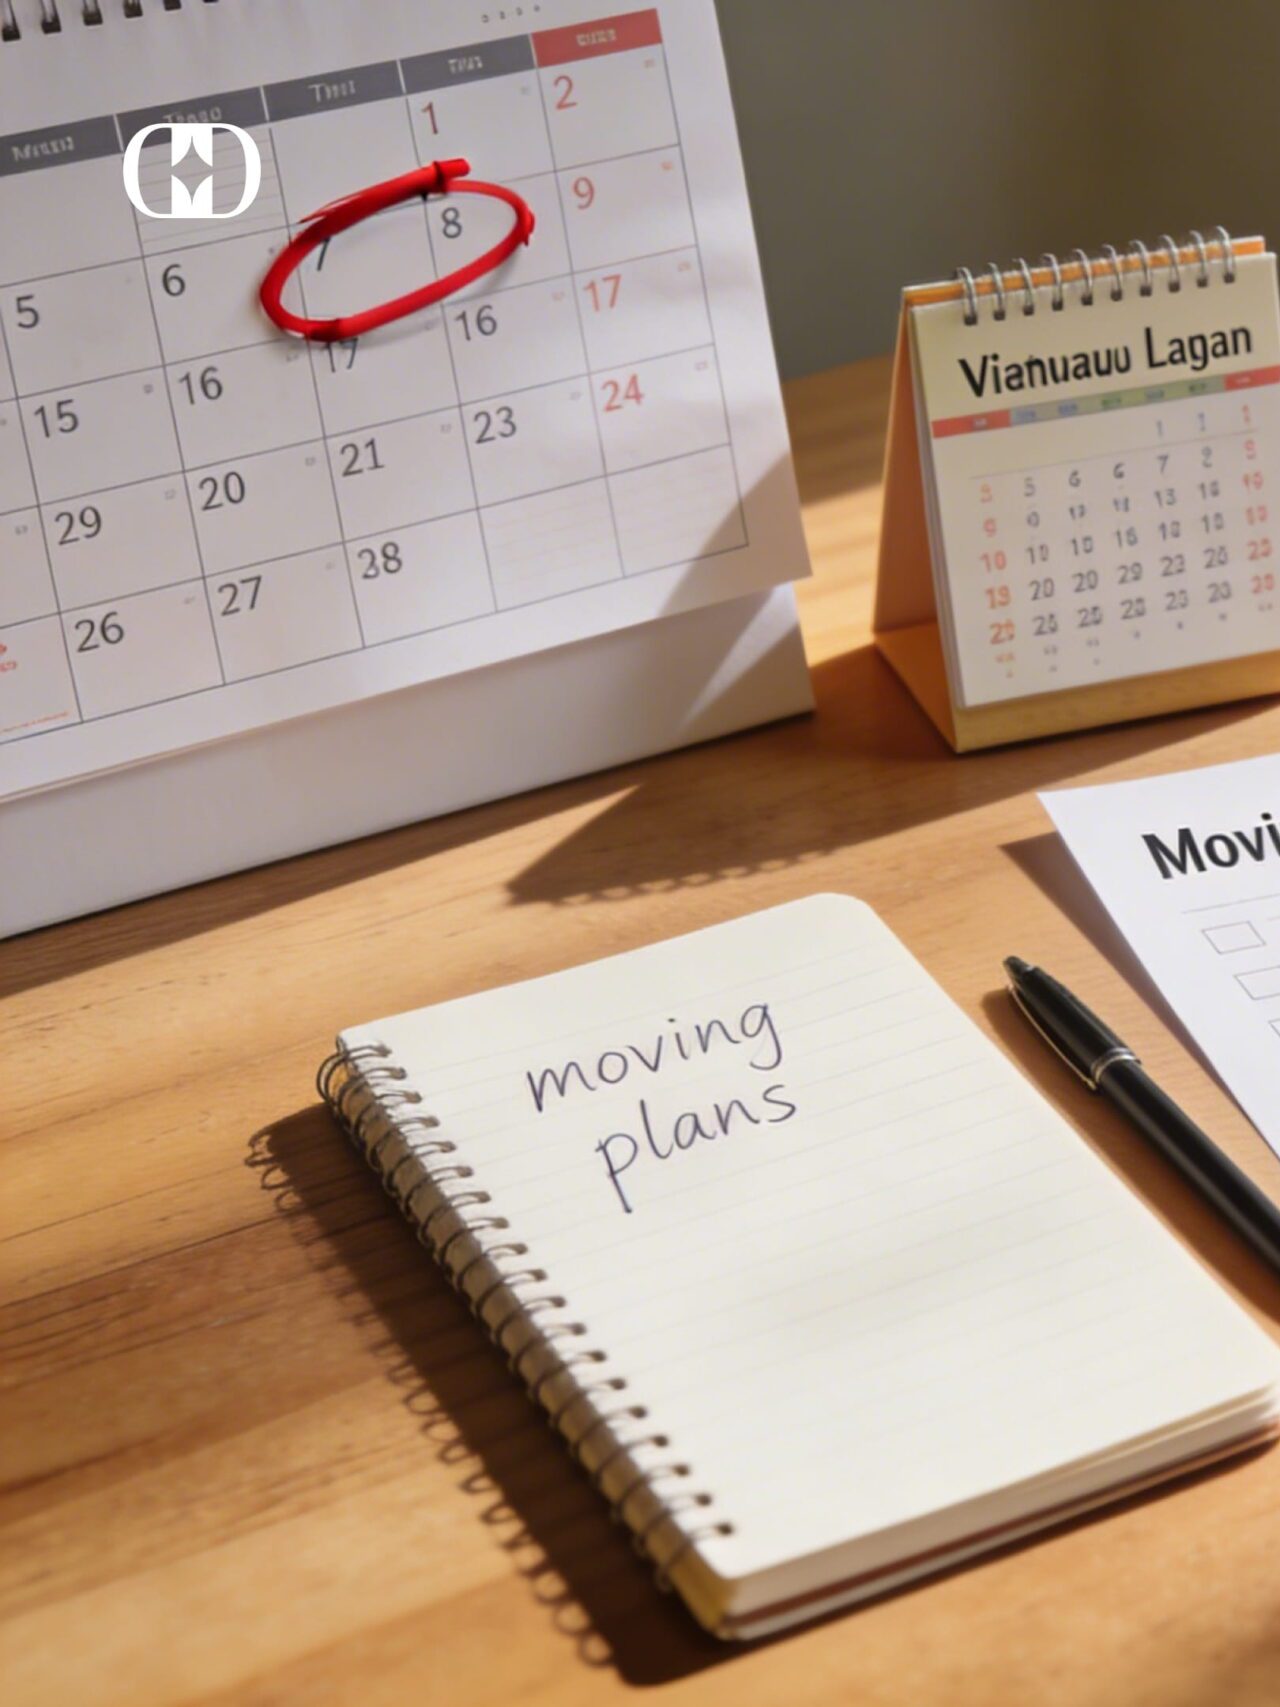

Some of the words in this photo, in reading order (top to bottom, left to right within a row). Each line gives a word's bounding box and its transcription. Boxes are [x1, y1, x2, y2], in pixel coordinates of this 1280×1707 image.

[420, 102, 439, 135] 1
[552, 75, 578, 110] 2
[15, 294, 40, 328] 5
[161, 263, 187, 297] 6
[441, 206, 463, 239] 8
[572, 176, 595, 210] 9
[33, 399, 79, 438] 15
[178, 366, 224, 405] 16
[454, 304, 498, 341] 16
[582, 274, 622, 312] 17
[1144, 325, 1253, 371] Lagan
[54, 505, 102, 545] 29
[198, 470, 246, 511] 20
[340, 438, 385, 477] 21
[472, 405, 518, 444] 23
[601, 374, 645, 412] 24
[1156, 454, 1169, 474] 7
[74, 612, 125, 653] 26
[217, 575, 263, 617] 27
[527, 1004, 782, 1113] moving
[595, 1084, 797, 1214] plans
